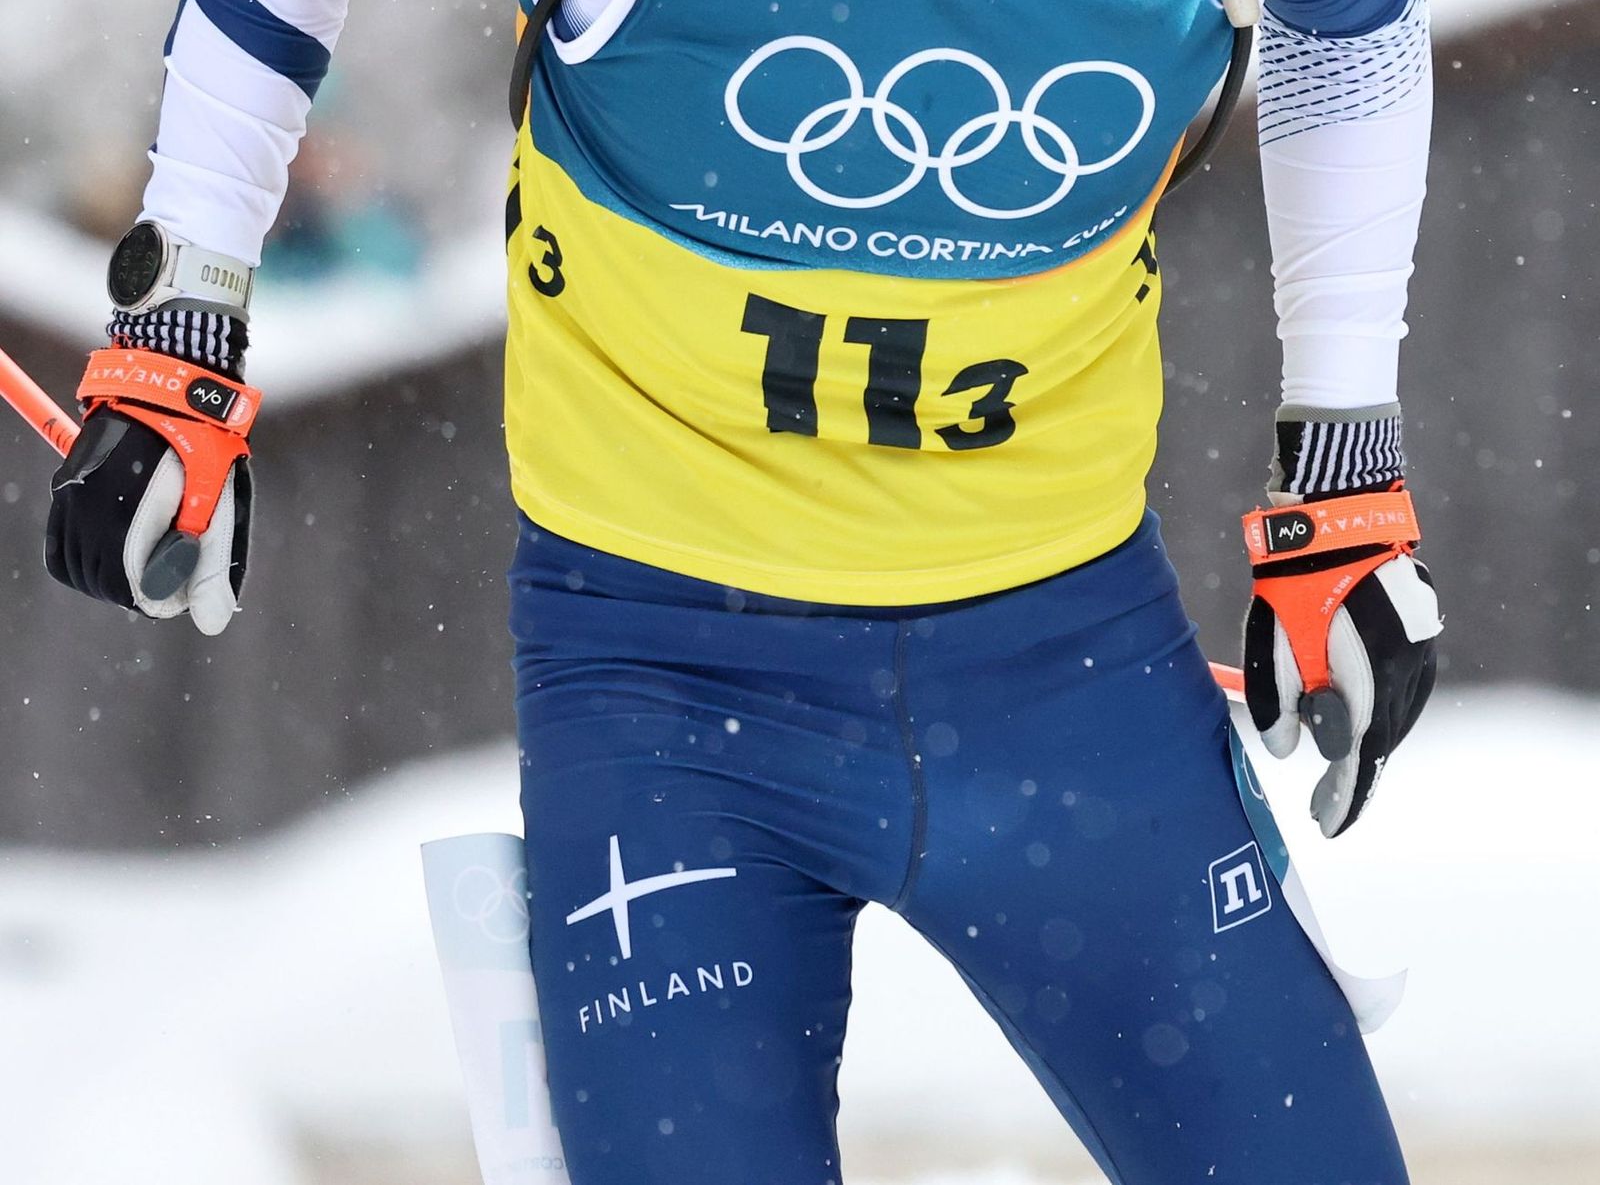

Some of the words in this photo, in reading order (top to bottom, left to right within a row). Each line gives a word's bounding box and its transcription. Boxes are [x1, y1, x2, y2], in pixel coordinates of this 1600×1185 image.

[528, 224, 566, 298] 3
[668, 203, 858, 252] MILANO
[866, 231, 1054, 261] CORTINA
[1249, 523, 1262, 548] LEFT
[578, 960, 754, 1034] FINLAND
